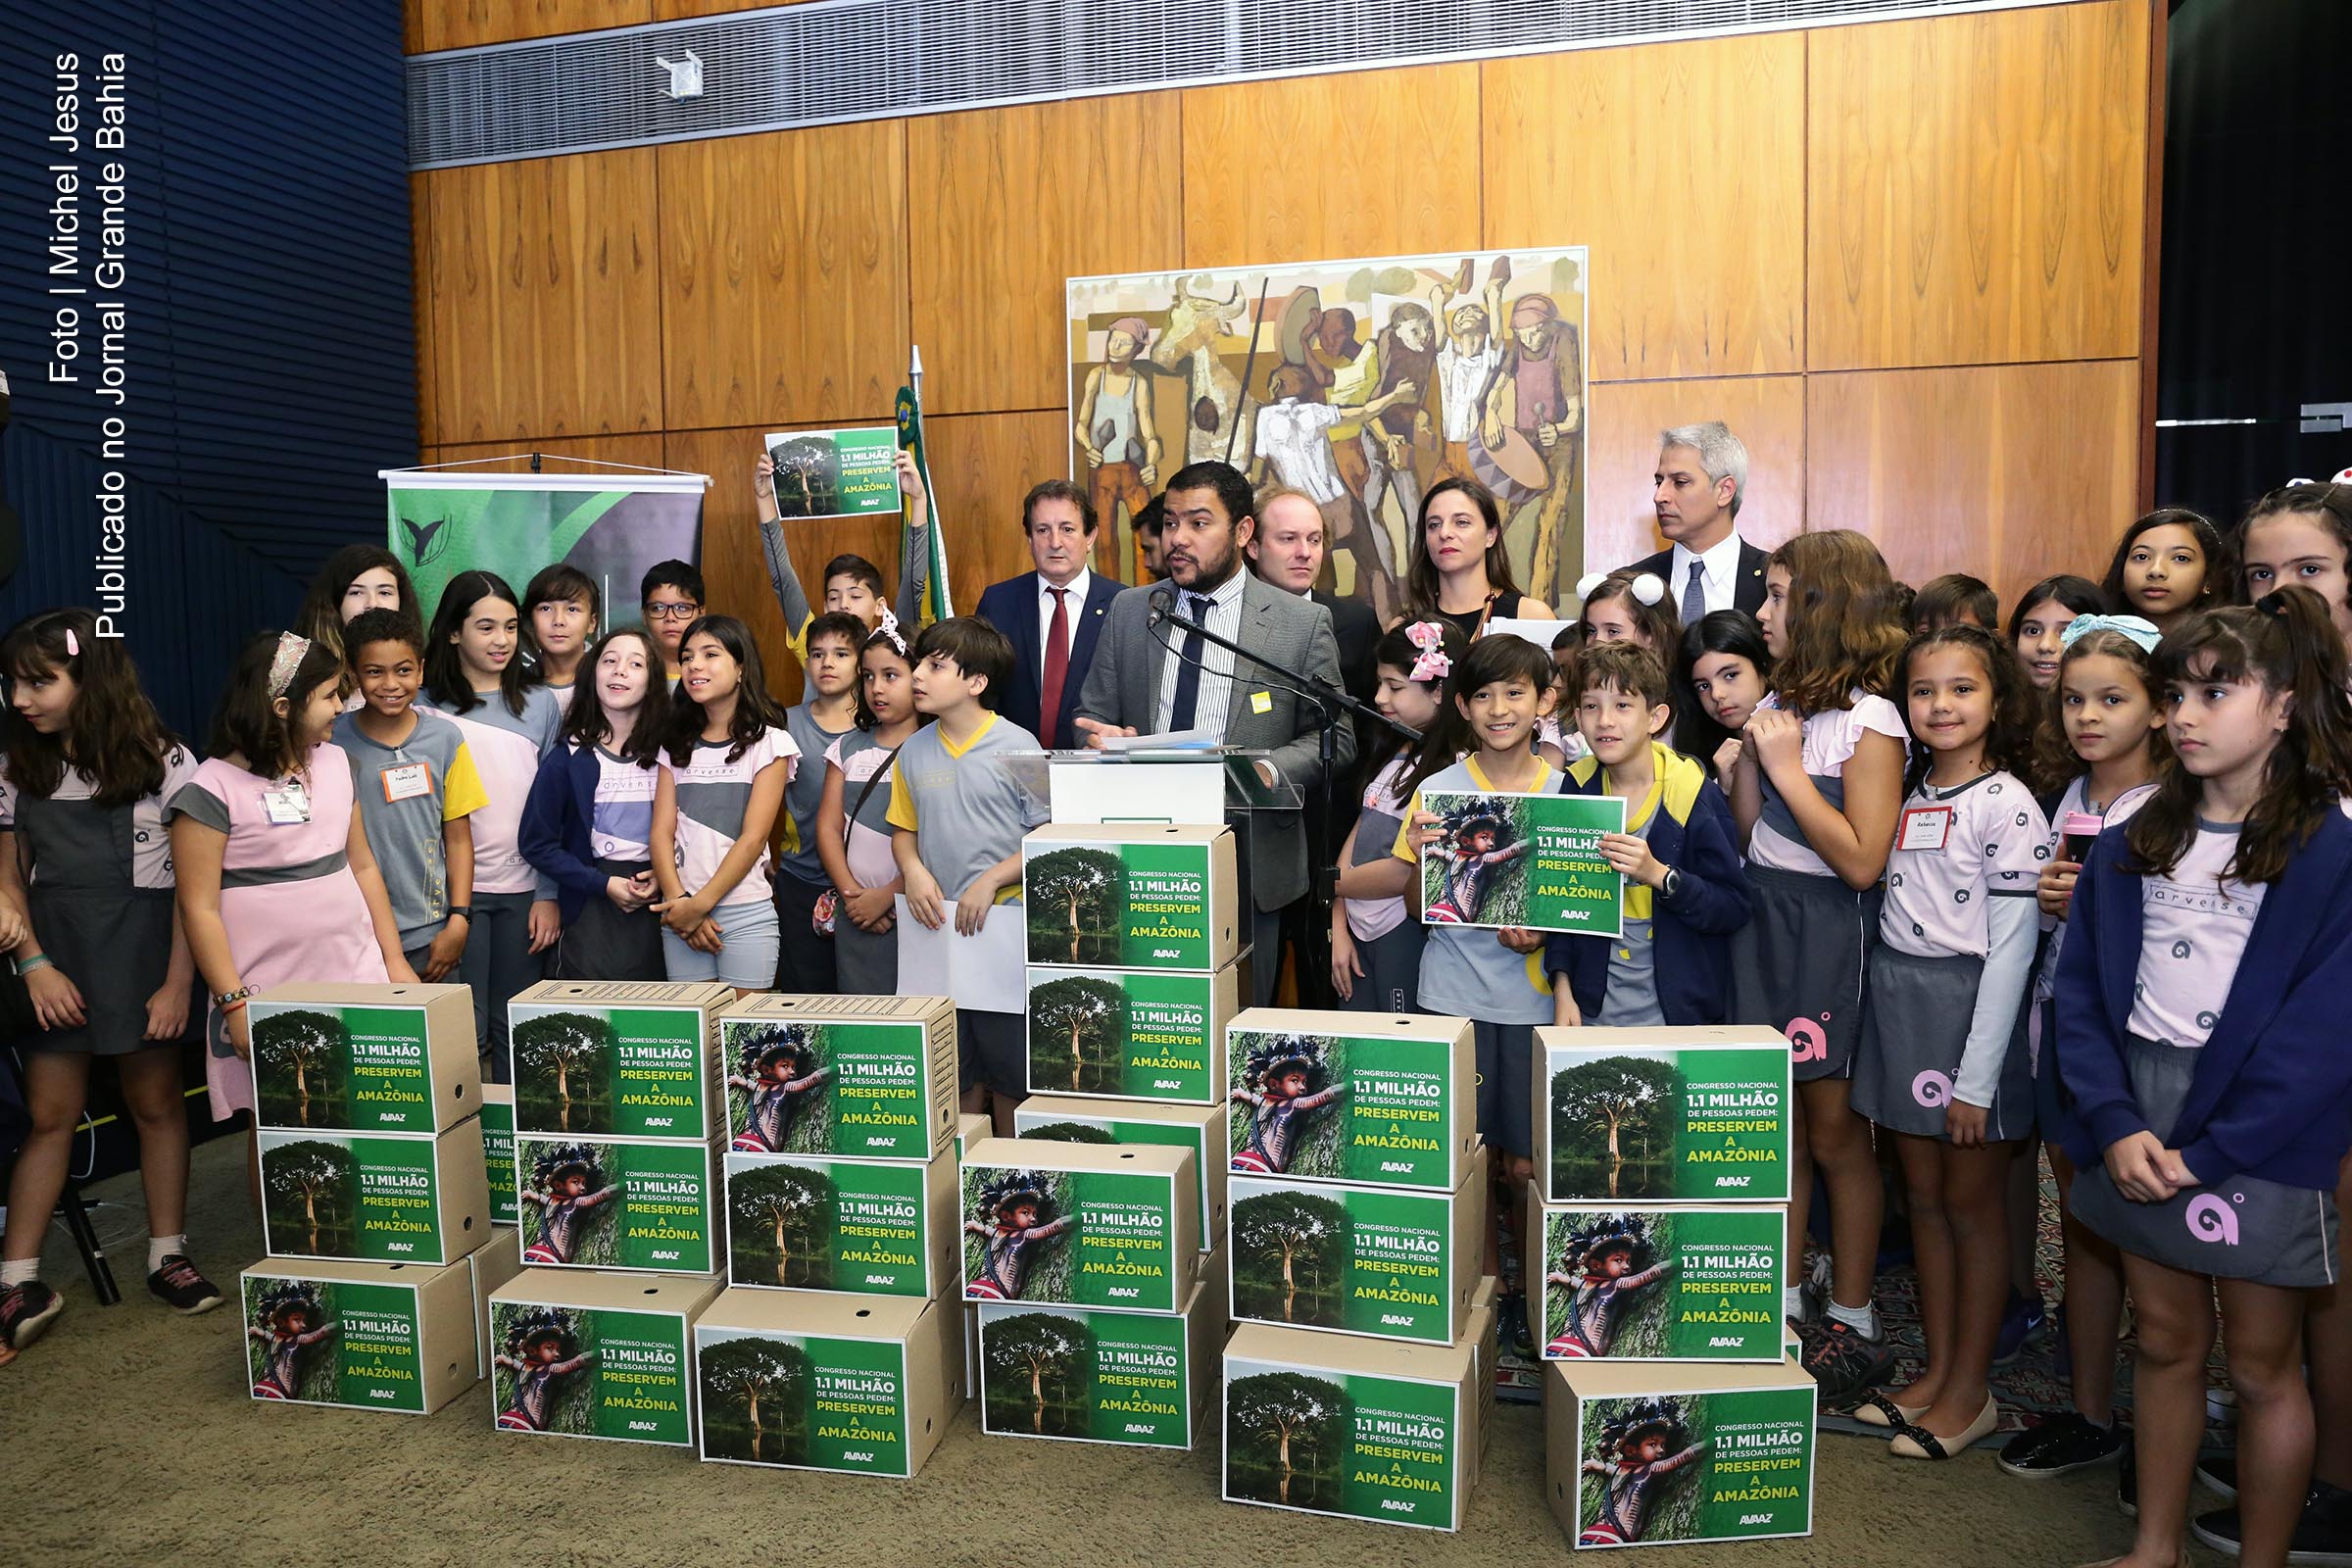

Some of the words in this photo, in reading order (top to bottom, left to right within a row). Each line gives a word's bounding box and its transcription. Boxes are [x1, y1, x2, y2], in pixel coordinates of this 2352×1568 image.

[853, 450, 890, 460] MILHÃO
[842, 466, 891, 476] PRESERVEM
[844, 482, 892, 493] AMAZÔNIA
[1537, 836, 1551, 847] 1.1
[1556, 836, 1601, 851] MILHÃ
[1538, 859, 1612, 873] PRESERVEM
[1129, 880, 1142, 891] 1.1
[1147, 879, 1201, 892] MILHÃO
[1568, 875, 1577, 884] A
[1538, 885, 1612, 899] AMAZÔNIA
[1130, 903, 1200, 913] PRESERVEM
[2155, 891, 2245, 914] arvese
[1561, 909, 1590, 920] AVAAZ
[1130, 925, 1201, 938] AMAZÔNIA
[1153, 949, 1180, 958] AVAAZ
[351, 1044, 365, 1055] 1.1
[368, 1043, 420, 1056] MILHÃO
[619, 1047, 633, 1057] 1.1
[637, 1045, 692, 1059] MILHÃO
[354, 1067, 421, 1077] PRESERVEM
[838, 1063, 853, 1074] 1.1
[857, 1061, 915, 1076] MILHÃO
[1353, 1069, 1399, 1077] CONGRESSO
[621, 1070, 692, 1080] PRESERVEM
[651, 1083, 659, 1092] A
[840, 1088, 915, 1098] PRESERVEM
[1353, 1080, 1370, 1093] 1.1
[1375, 1080, 1440, 1097] MILHÃO
[356, 1089, 424, 1102] AMAZÔNIA
[621, 1093, 693, 1105] AMAZÔNIA
[1368, 1096, 1406, 1105] PESSOAS
[1409, 1098, 1440, 1107] PEDEM:
[1686, 1094, 1704, 1107] 1.1
[1709, 1090, 1778, 1106] MILHÃO
[872, 1102, 881, 1110] A
[379, 1113, 405, 1121] AVAAZ
[841, 1112, 917, 1125] AMAZÔNIA
[1355, 1106, 1439, 1121] PRESERVEM
[645, 1117, 673, 1126] AVAAZ
[1688, 1121, 1776, 1132] PRESERVEM
[1389, 1123, 1399, 1133] A
[866, 1137, 896, 1146] AVAAZ
[1354, 1134, 1439, 1150] AMAZÔNIA
[1725, 1136, 1735, 1146] A
[1687, 1147, 1776, 1161] AMAZÔNIA
[1380, 1161, 1414, 1172] AVAAZ
[1715, 1176, 1750, 1186] AVAAZ
[1081, 1212, 1097, 1223] 1.1
[1101, 1212, 1162, 1227] MILHÃO
[1083, 1236, 1161, 1249] PRESERVEM
[1116, 1252, 1125, 1260] A
[1681, 1256, 1699, 1268] 1.1
[1704, 1252, 1773, 1268] MILHÃO
[1082, 1262, 1162, 1276] AMAZÔNIA
[1108, 1287, 1139, 1297] AVAAZ
[1681, 1308, 1770, 1322] AMAZÔNIA
[814, 1366, 857, 1375] CONGRESSO
[815, 1377, 830, 1388] 1.1
[835, 1378, 895, 1393] MILHÃO
[829, 1391, 864, 1400] PESSOAS
[817, 1401, 894, 1415] PRESERVEM
[850, 1417, 859, 1425] A
[1355, 1407, 1402, 1418] CONGRESSO
[1404, 1413, 1445, 1423] NACIONAL
[1355, 1418, 1372, 1431] 1.1
[1377, 1420, 1444, 1439] MILHÃO
[1715, 1423, 1762, 1431] CONGRESSO
[818, 1426, 896, 1441] AMAZÔNIA
[1715, 1436, 1732, 1448] 1.1
[1737, 1429, 1802, 1447] MILHÃO
[1370, 1434, 1409, 1445] PESSOAS
[1411, 1439, 1443, 1450] PEDEM:
[843, 1451, 874, 1461] AVAAZ
[1355, 1443, 1442, 1464] PRESERVEM
[1729, 1449, 1768, 1457] PESSOAS
[1391, 1463, 1401, 1472] A
[1715, 1458, 1800, 1473] PRESERVEM
[1354, 1471, 1441, 1492] AMAZÔNIA
[1750, 1475, 1760, 1485] A
[1713, 1485, 1798, 1502] AMAZÔNIA
[1381, 1499, 1415, 1512] AVAAZ
[1739, 1513, 1773, 1524] AVAAZ
